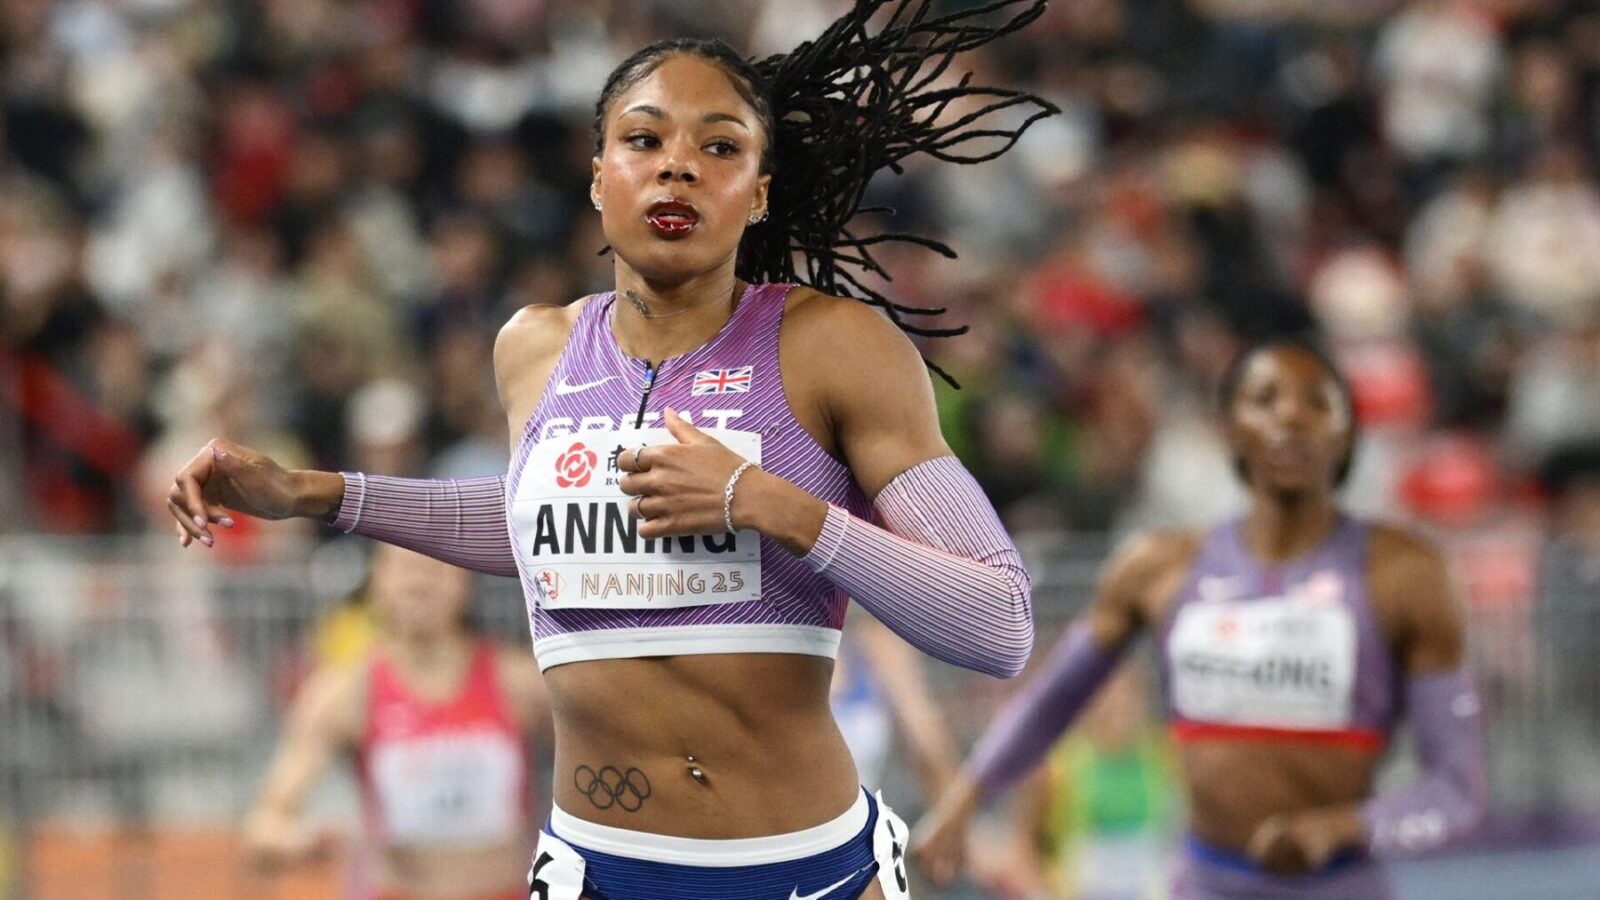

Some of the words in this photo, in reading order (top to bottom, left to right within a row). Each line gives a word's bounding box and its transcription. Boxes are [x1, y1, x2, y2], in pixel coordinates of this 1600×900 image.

[541, 409, 743, 438] GRET
[581, 569, 705, 602] NANJING
[712, 571, 744, 593] 25
